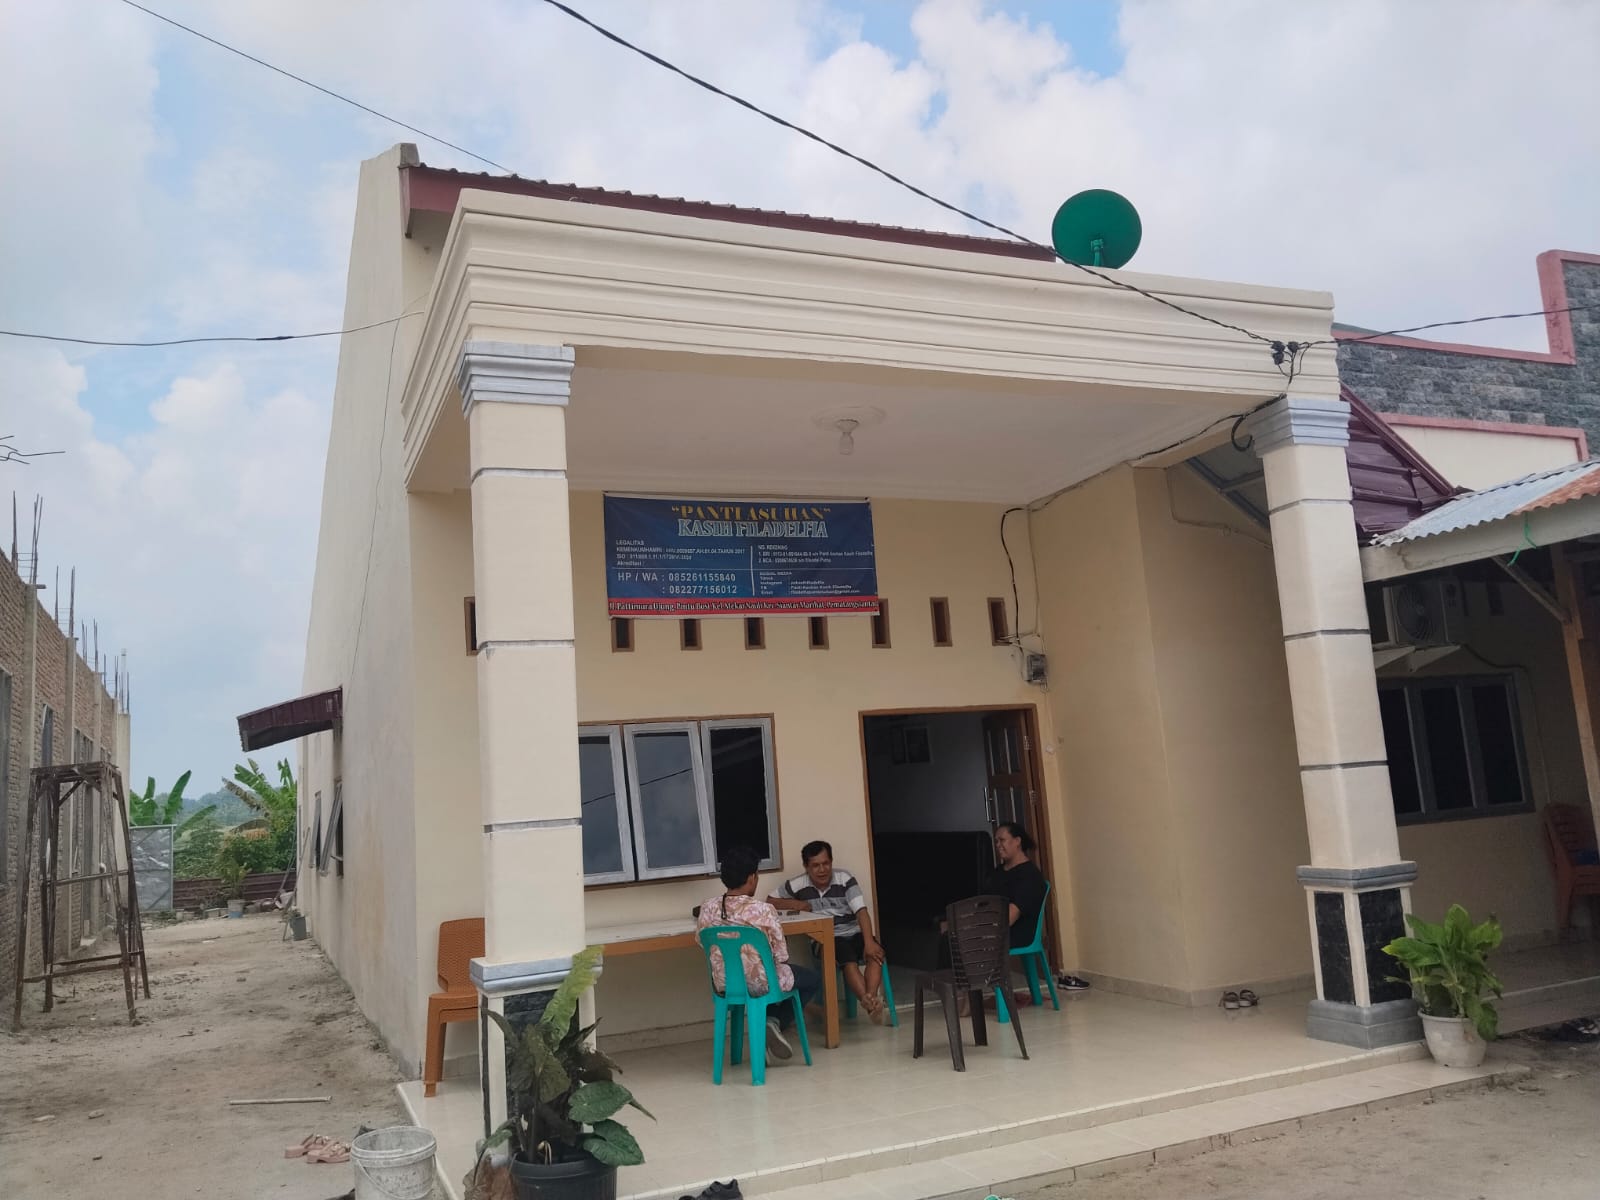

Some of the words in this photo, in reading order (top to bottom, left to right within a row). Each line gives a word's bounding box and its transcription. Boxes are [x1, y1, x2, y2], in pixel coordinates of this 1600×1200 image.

[678, 519, 733, 537] KASIH
[734, 520, 829, 538] FILADELFIA
[617, 572, 632, 582] HP
[641, 572, 658, 582] WA
[668, 573, 737, 582] 085261155840
[669, 585, 737, 594] 082277156012
[617, 602, 653, 610] Pattimura
